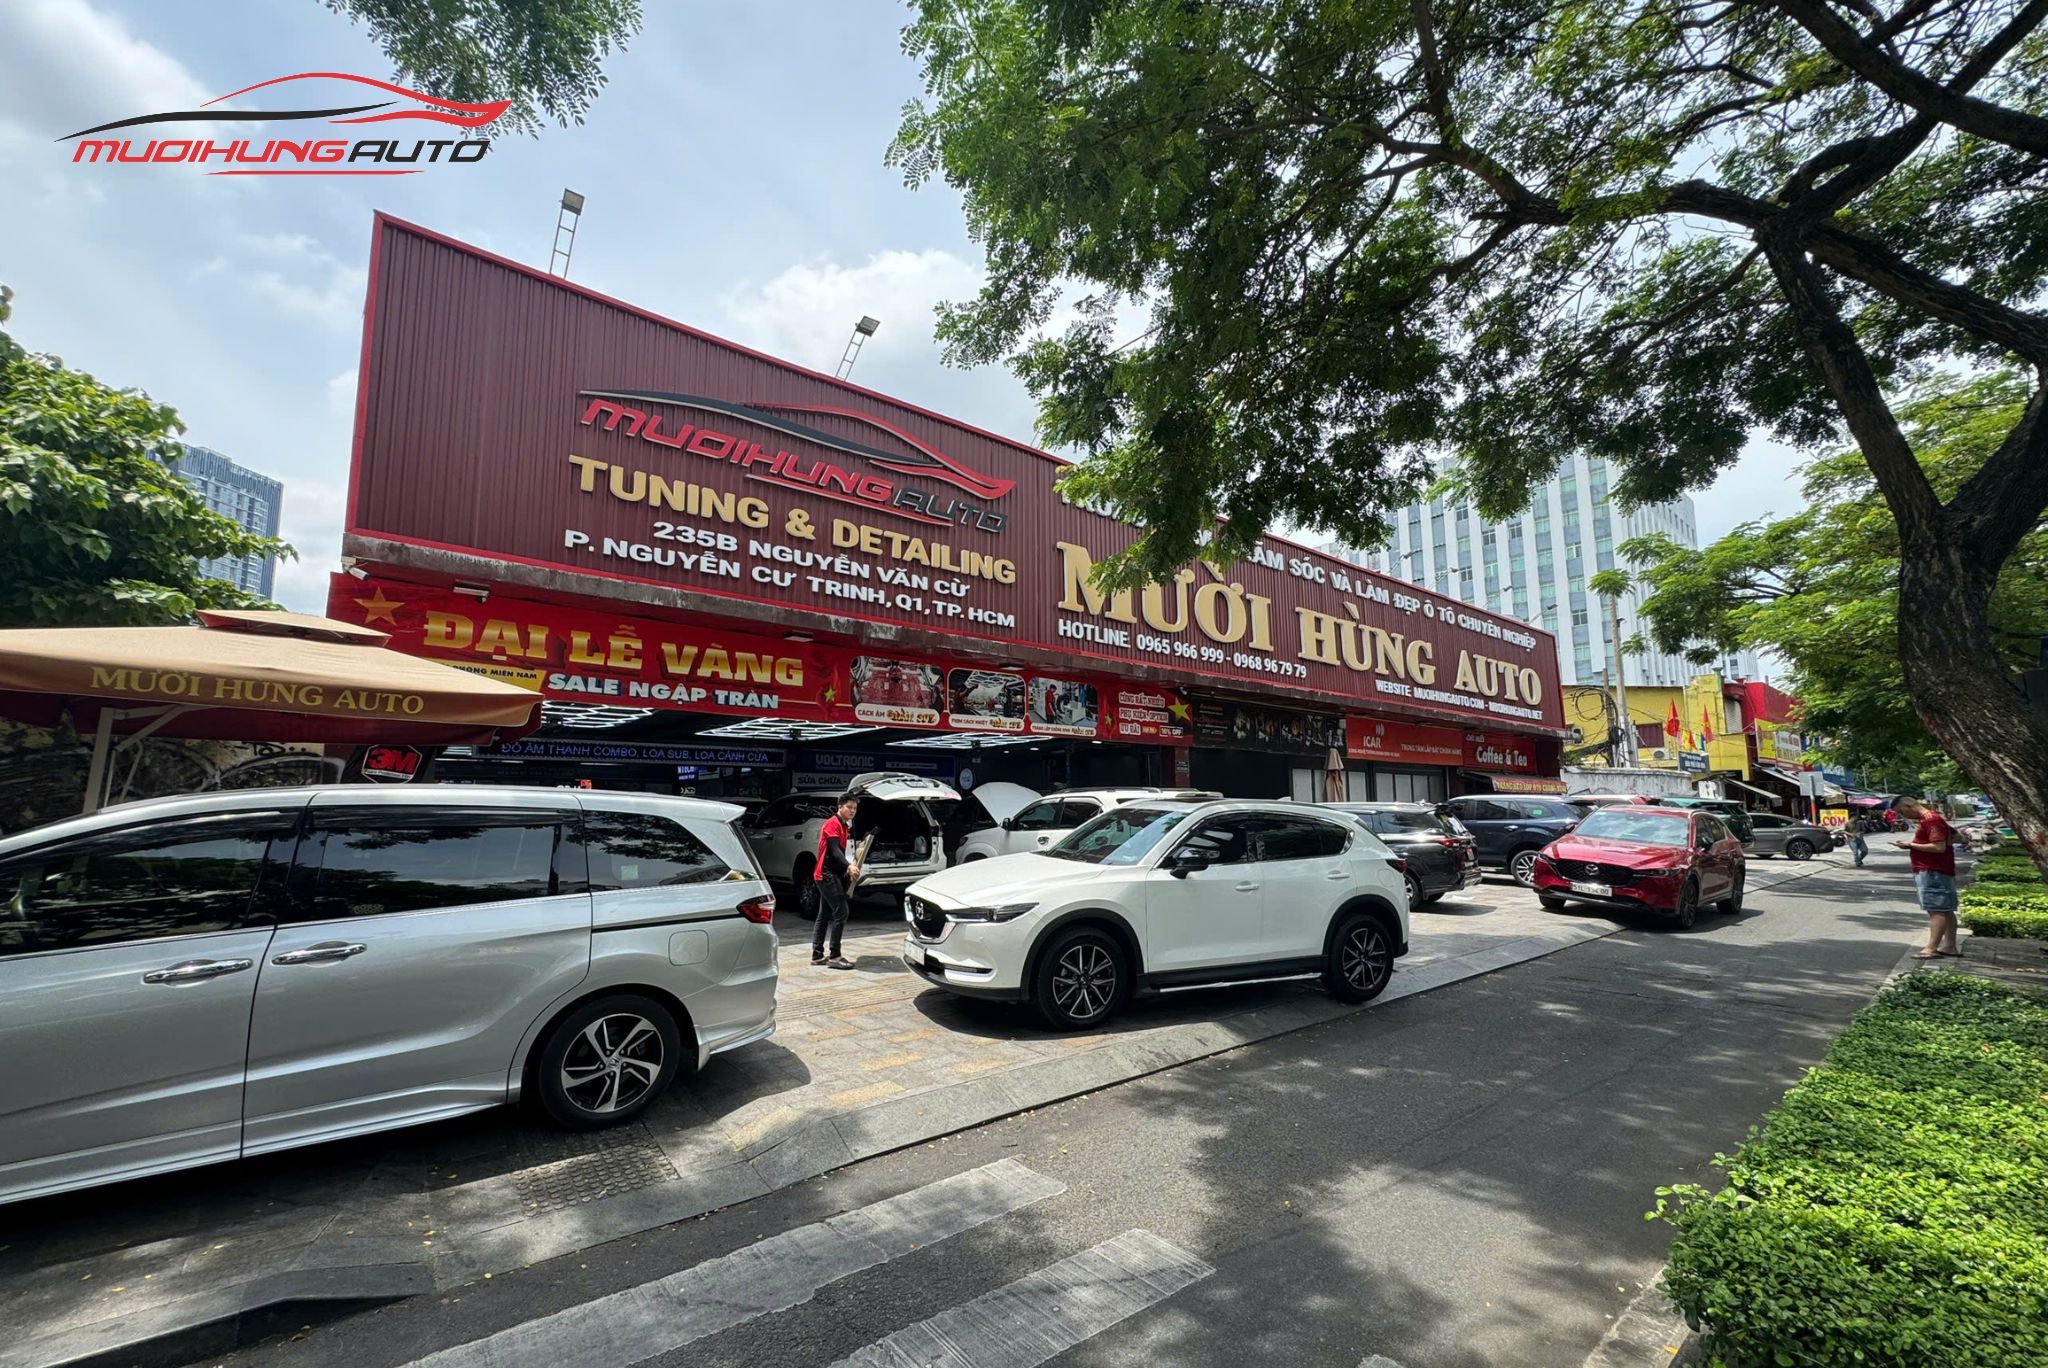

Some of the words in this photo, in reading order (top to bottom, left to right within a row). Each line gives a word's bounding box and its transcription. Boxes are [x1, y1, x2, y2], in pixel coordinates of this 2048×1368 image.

[568, 453, 769, 529] TUNING
[785, 508, 817, 541] &
[832, 518, 1016, 584] DETAILING
[564, 529, 595, 552] P.
[602, 537, 741, 578] NGUYỄN
[751, 565, 798, 588] CƯ
[653, 521, 738, 551] 235B
[749, 539, 871, 579] NGUYỄN
[876, 566, 929, 591] VĂN
[933, 577, 971, 598] CỪ
[1056, 541, 1275, 652] MƯỜI
[1295, 601, 1437, 686] HÙNG
[1453, 650, 1543, 706] AUTO
[1288, 556, 1326, 585] SÓC
[1329, 569, 1353, 593] VÀ
[1355, 579, 1390, 605] LÀM
[1393, 592, 1421, 616] ĐẸP
[1423, 599, 1436, 619] Ô
[1437, 606, 1456, 626] TÔ
[1457, 614, 1502, 640] CHUYÊN
[1502, 628, 1538, 654] NGHIỆP
[423, 611, 549, 661] ĐẠI
[569, 624, 643, 670] LỄ
[661, 642, 804, 687] VÀNG
[1136, 633, 1171, 655] 0965
[1173, 641, 1198, 660] 966
[1201, 648, 1224, 664] 999
[1233, 652, 1263, 672] 0968
[1264, 659, 1279, 674] 96
[1279, 663, 1293, 677] 79
[1293, 663, 1308, 680] 79
[516, 672, 538, 680] NAM
[548, 673, 622, 696] SALE
[629, 681, 708, 704] NGẬP
[714, 689, 779, 709] TRÀN
[333, 689, 425, 714] AUTO
[370, 747, 418, 774] 3M
[548, 744, 590, 756] THANH
[694, 751, 715, 760] LOA
[1363, 736, 1382, 748] ICAR
[1476, 746, 1503, 765] Coffee
[1505, 749, 1512, 765] &
[1513, 750, 1528, 767] Tea
